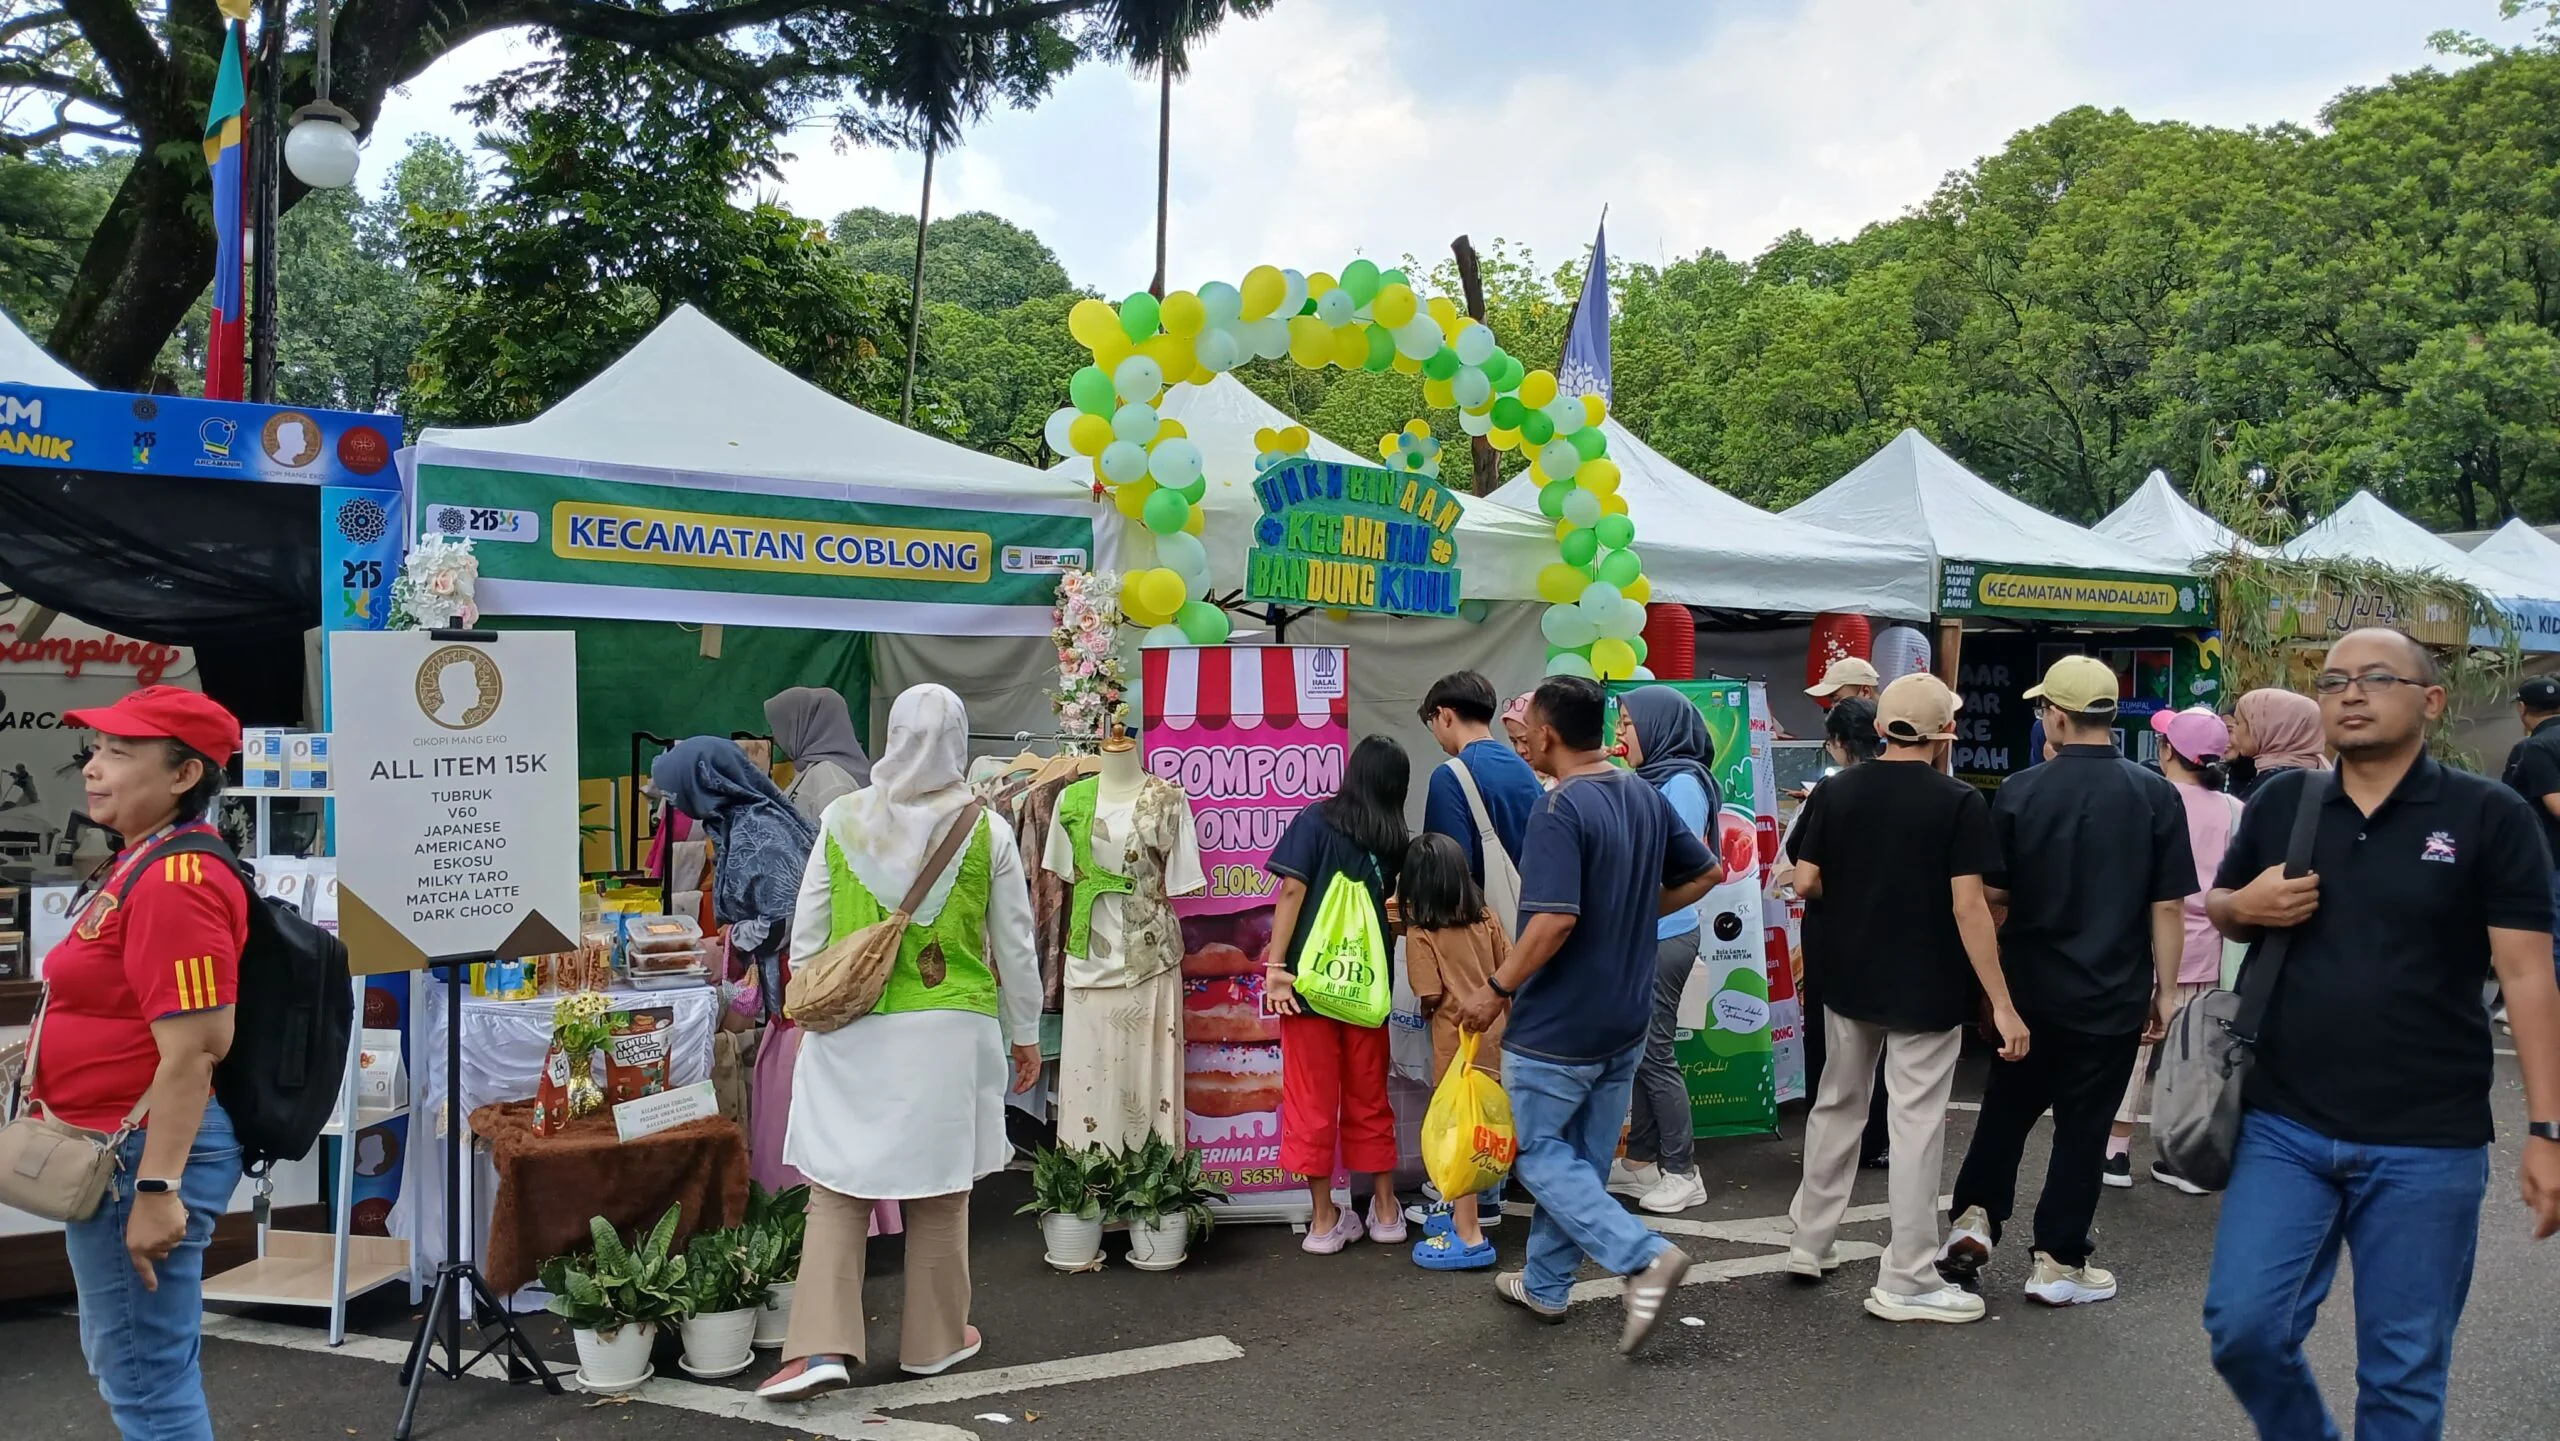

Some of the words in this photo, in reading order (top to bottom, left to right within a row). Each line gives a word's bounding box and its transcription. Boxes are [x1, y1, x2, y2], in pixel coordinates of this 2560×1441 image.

[0, 429, 74, 462] ANIK
[194, 459, 242, 469] ARCAMANIK
[1349, 467, 1461, 534] BINAAN
[470, 509, 499, 531] 215
[569, 516, 805, 562] KECAMATAN
[814, 535, 978, 572] COBLONG
[1288, 511, 1430, 565] KECAMATAN
[1057, 554, 1080, 565] JITU
[342, 560, 382, 588] 215
[1944, 565, 1975, 576] BAZAAR
[1252, 554, 1376, 606] BANDUNG
[1380, 566, 1456, 614] KIDUL
[1946, 576, 1971, 587] BAYAR
[1987, 581, 2073, 602] KECAMATAN
[2075, 587, 2169, 606] MANDALAJATI
[412, 736, 448, 747] CIKOPI
[451, 735, 483, 746] MANG
[486, 734, 507, 744] EKO
[370, 759, 424, 781] ALL
[434, 756, 496, 778] ITEM
[504, 753, 548, 774] 15K
[1149, 744, 1344, 799] POMPOM
[431, 789, 492, 803] TUBRUK
[448, 806, 477, 818] V60
[424, 821, 501, 837] JAPANESE
[1193, 807, 1303, 852] ONUT
[414, 838, 507, 855] AMERICANO
[433, 855, 493, 870] ESKOSU
[418, 873, 463, 888] MILKY
[468, 870, 508, 884] TARO
[406, 891, 470, 906] MATCHA
[475, 885, 520, 899] LATTE
[413, 906, 455, 922] DARK
[459, 902, 514, 918] CHOCO
[1310, 952, 1375, 986] LORD
[615, 1034, 653, 1051] PENTOL
[1199, 1146, 1253, 1164] ERIMA
[1256, 1145, 1281, 1162] PE
[1198, 1170, 1234, 1187] 878
[1240, 1168, 1284, 1186] 5654
